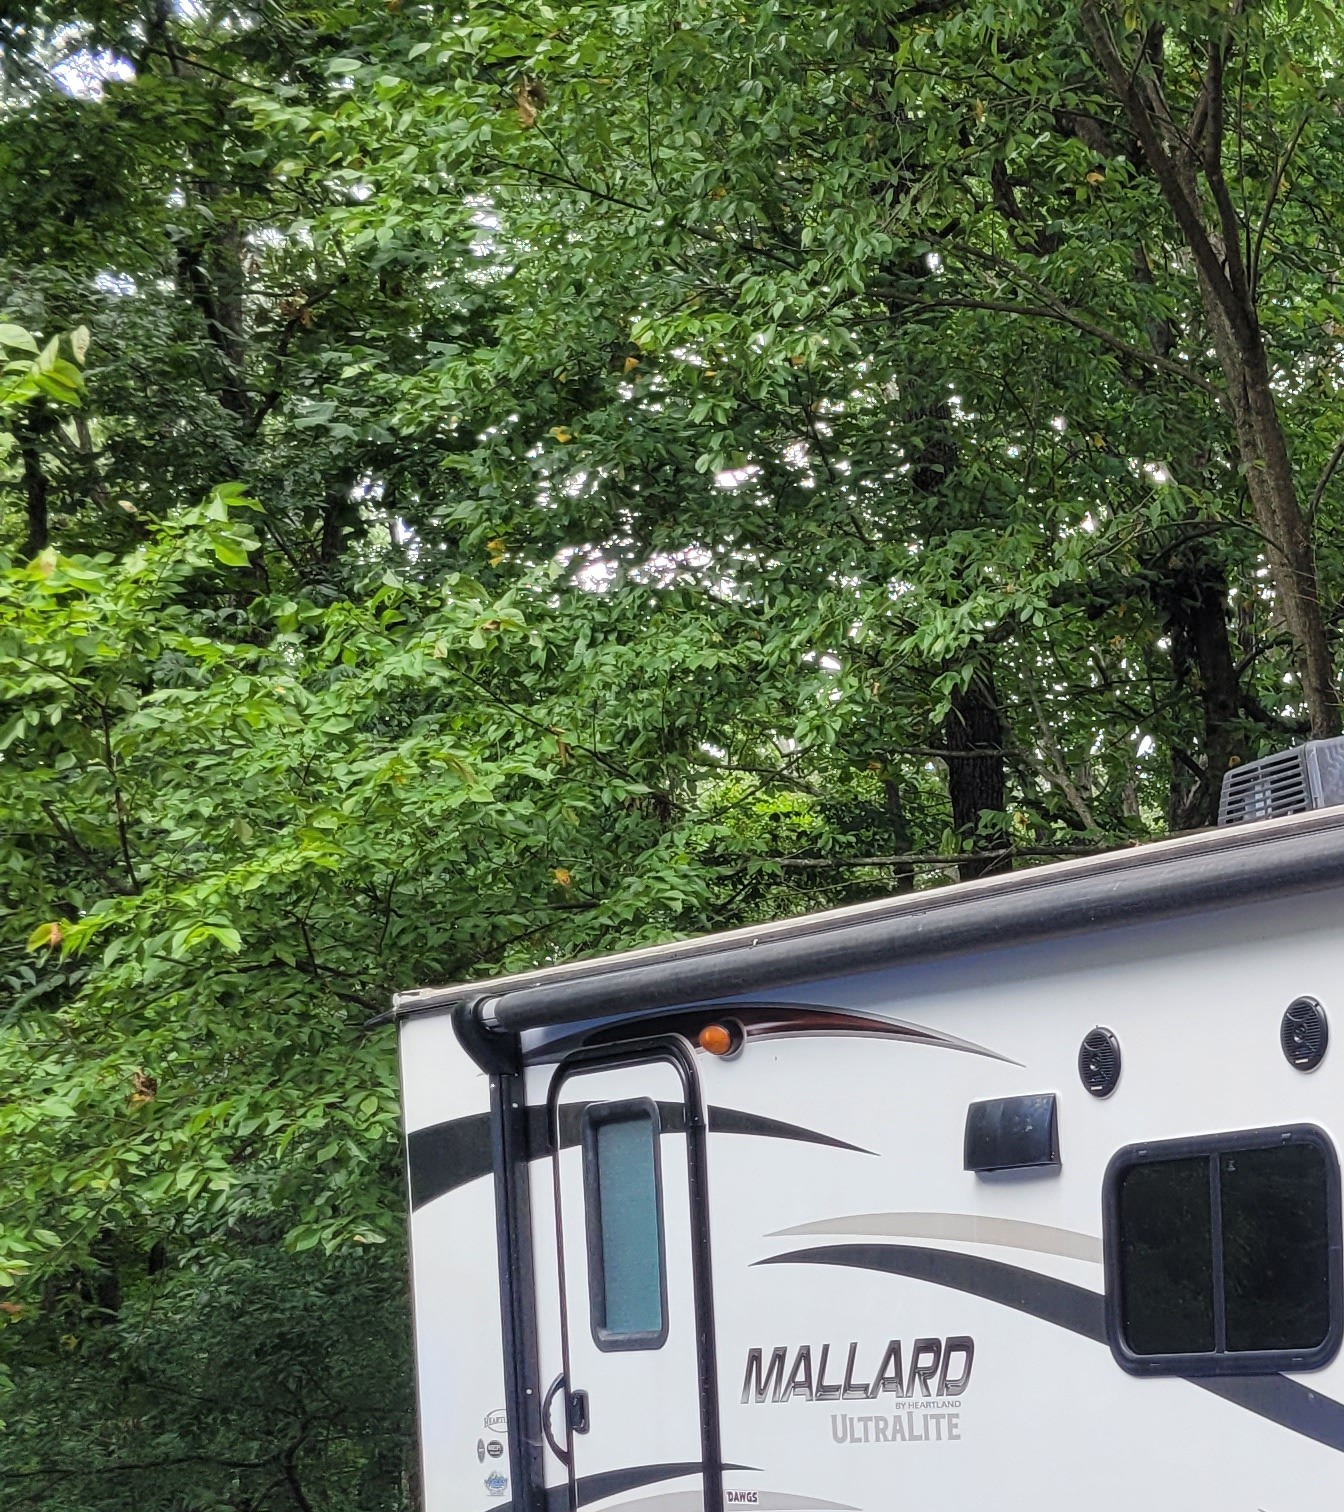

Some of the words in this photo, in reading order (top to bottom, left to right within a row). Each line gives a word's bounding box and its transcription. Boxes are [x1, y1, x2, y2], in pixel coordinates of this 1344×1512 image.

[740, 1335, 975, 1404] MALLARD
[895, 1402, 907, 1410] BY
[908, 1400, 962, 1410] HEARTLAND
[483, 1416, 508, 1429] HEARTL
[831, 1411, 961, 1443] ULTRALITE
[726, 1491, 758, 1503] DAWGS
